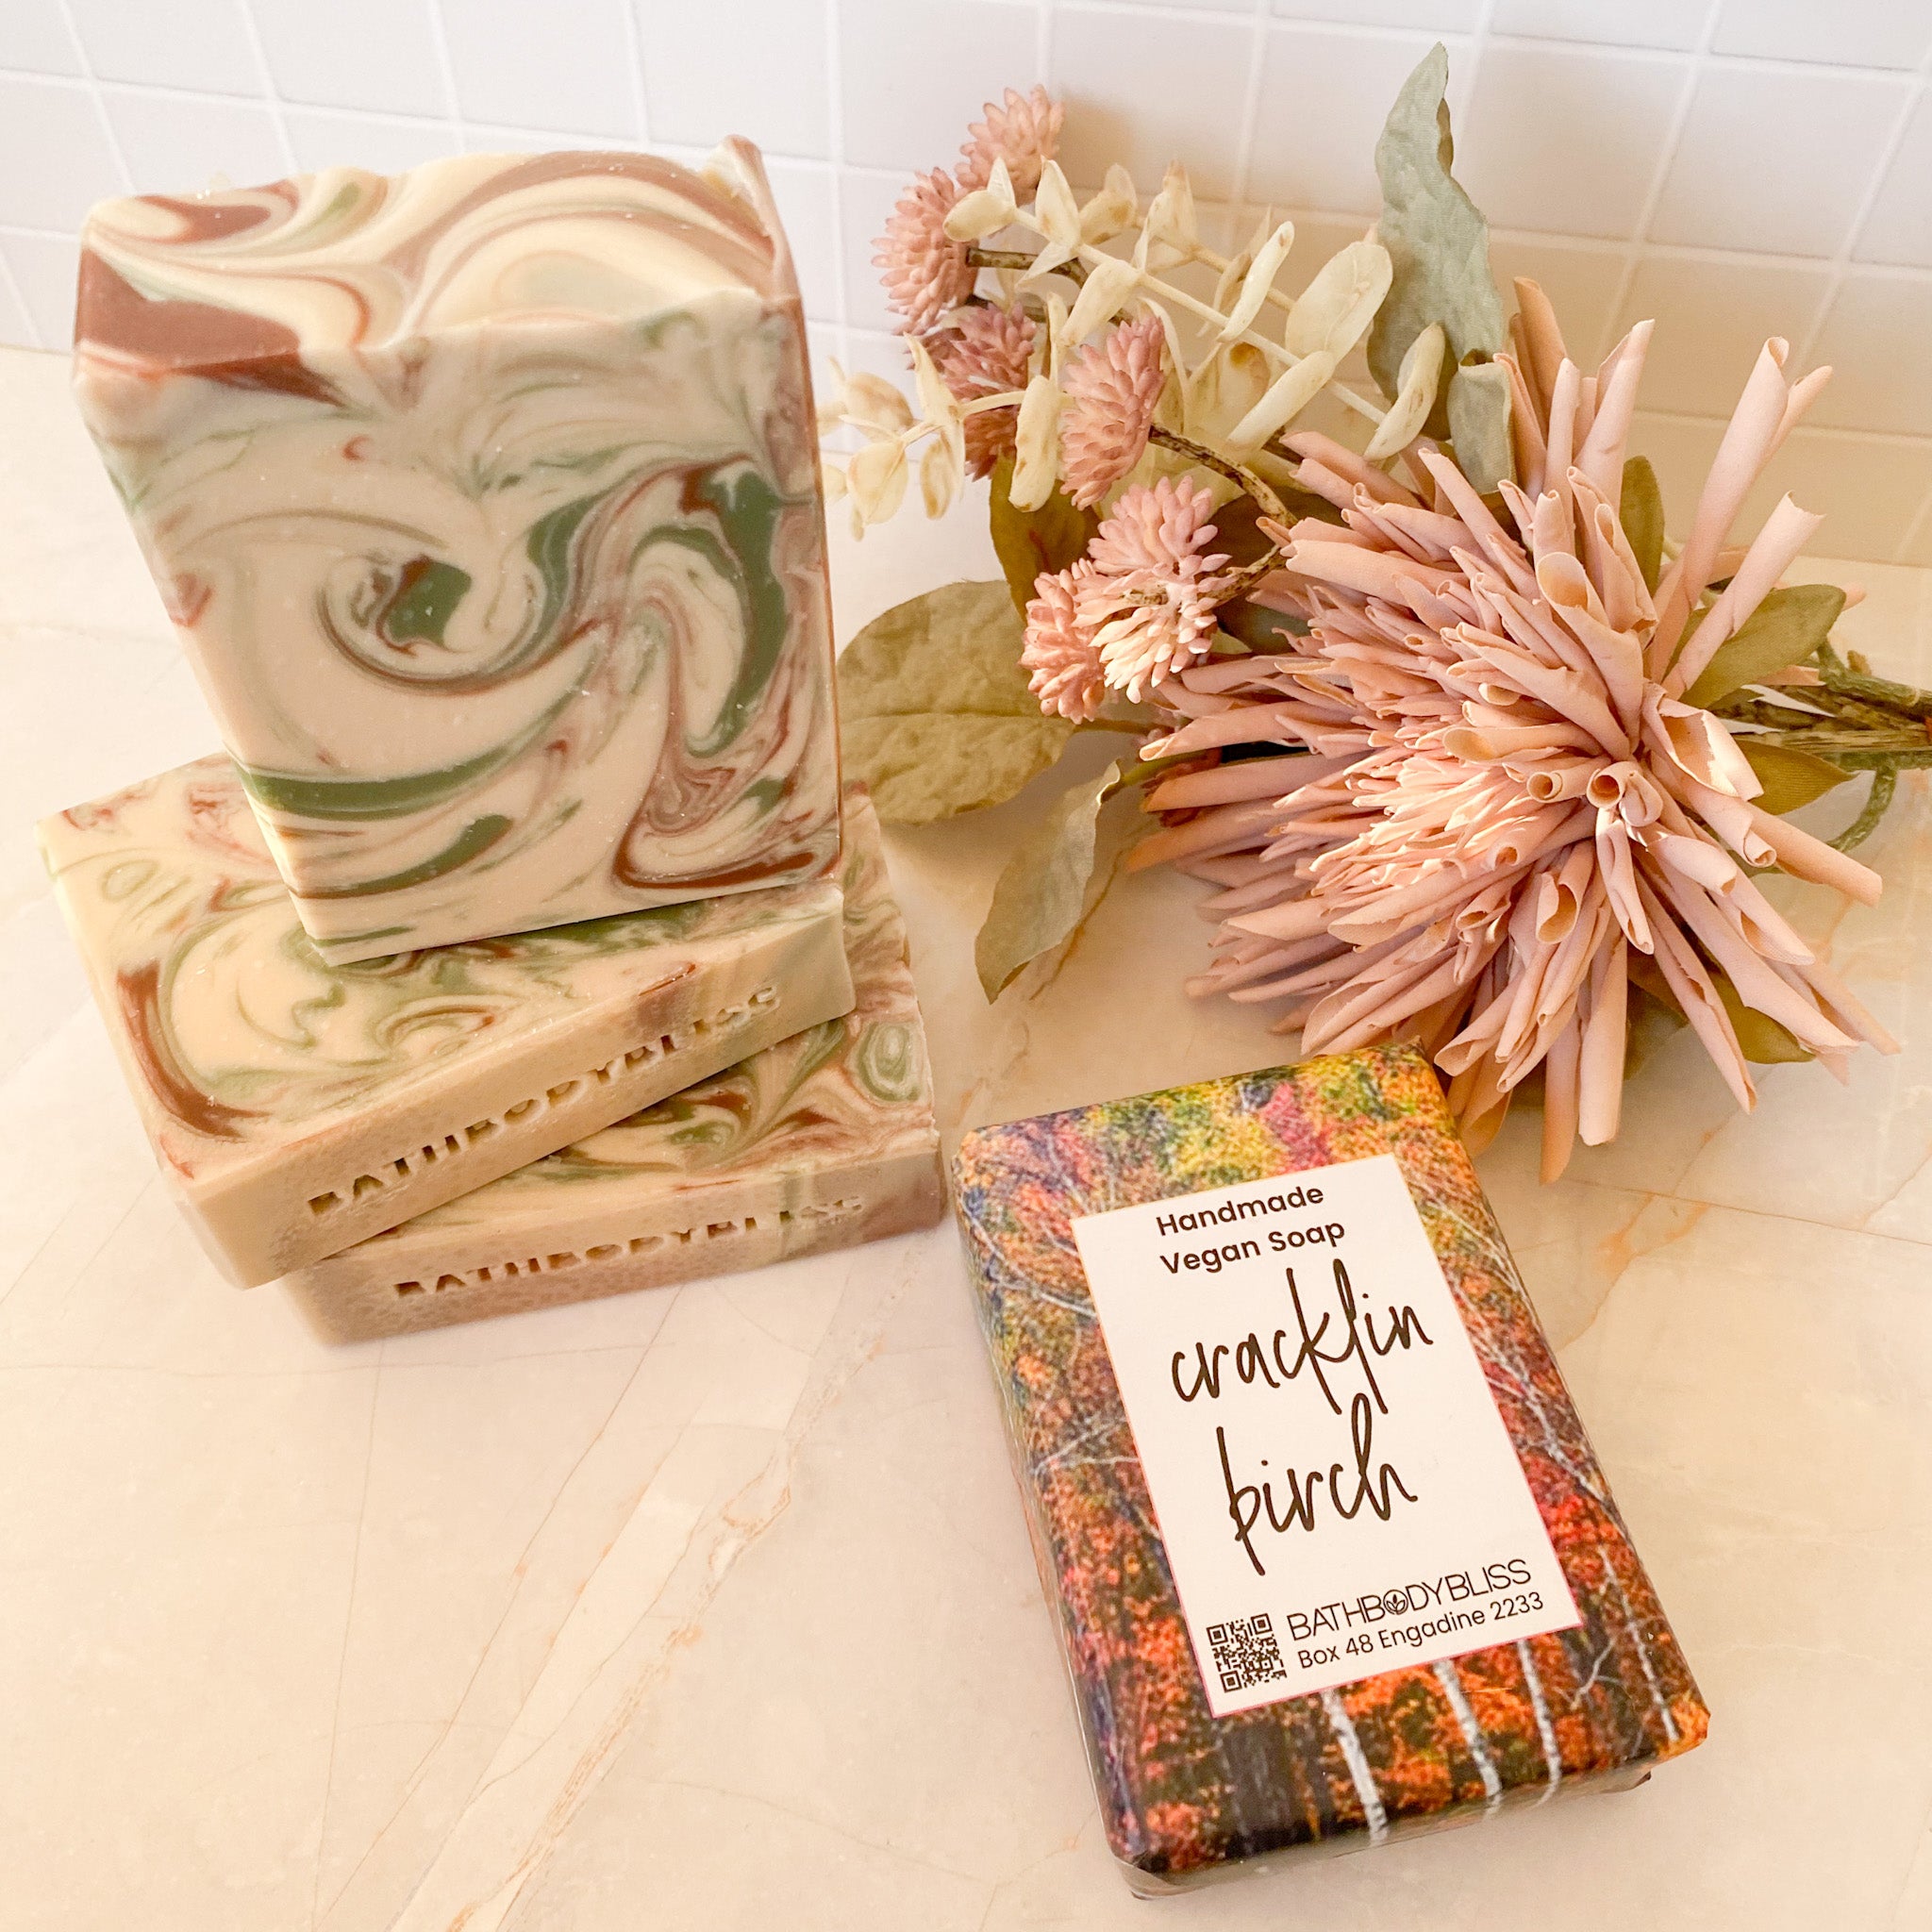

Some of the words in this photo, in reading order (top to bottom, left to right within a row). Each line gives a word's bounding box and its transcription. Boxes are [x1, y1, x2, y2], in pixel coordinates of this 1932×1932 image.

[1156, 1186, 1324, 1237] Handmade
[1159, 1240, 1261, 1274] Vegan
[1268, 1223, 1345, 1252] Soap
[1172, 1258, 1434, 1415] cracklin
[1216, 1392, 1418, 1576] birch
[1287, 1558, 1532, 1641] BATHBODYBLISS
[1298, 1646, 1341, 1669] Box
[1346, 1634, 1374, 1657] 48
[1378, 1608, 1486, 1647] Engadine
[1490, 1591, 1544, 1621] 2233
